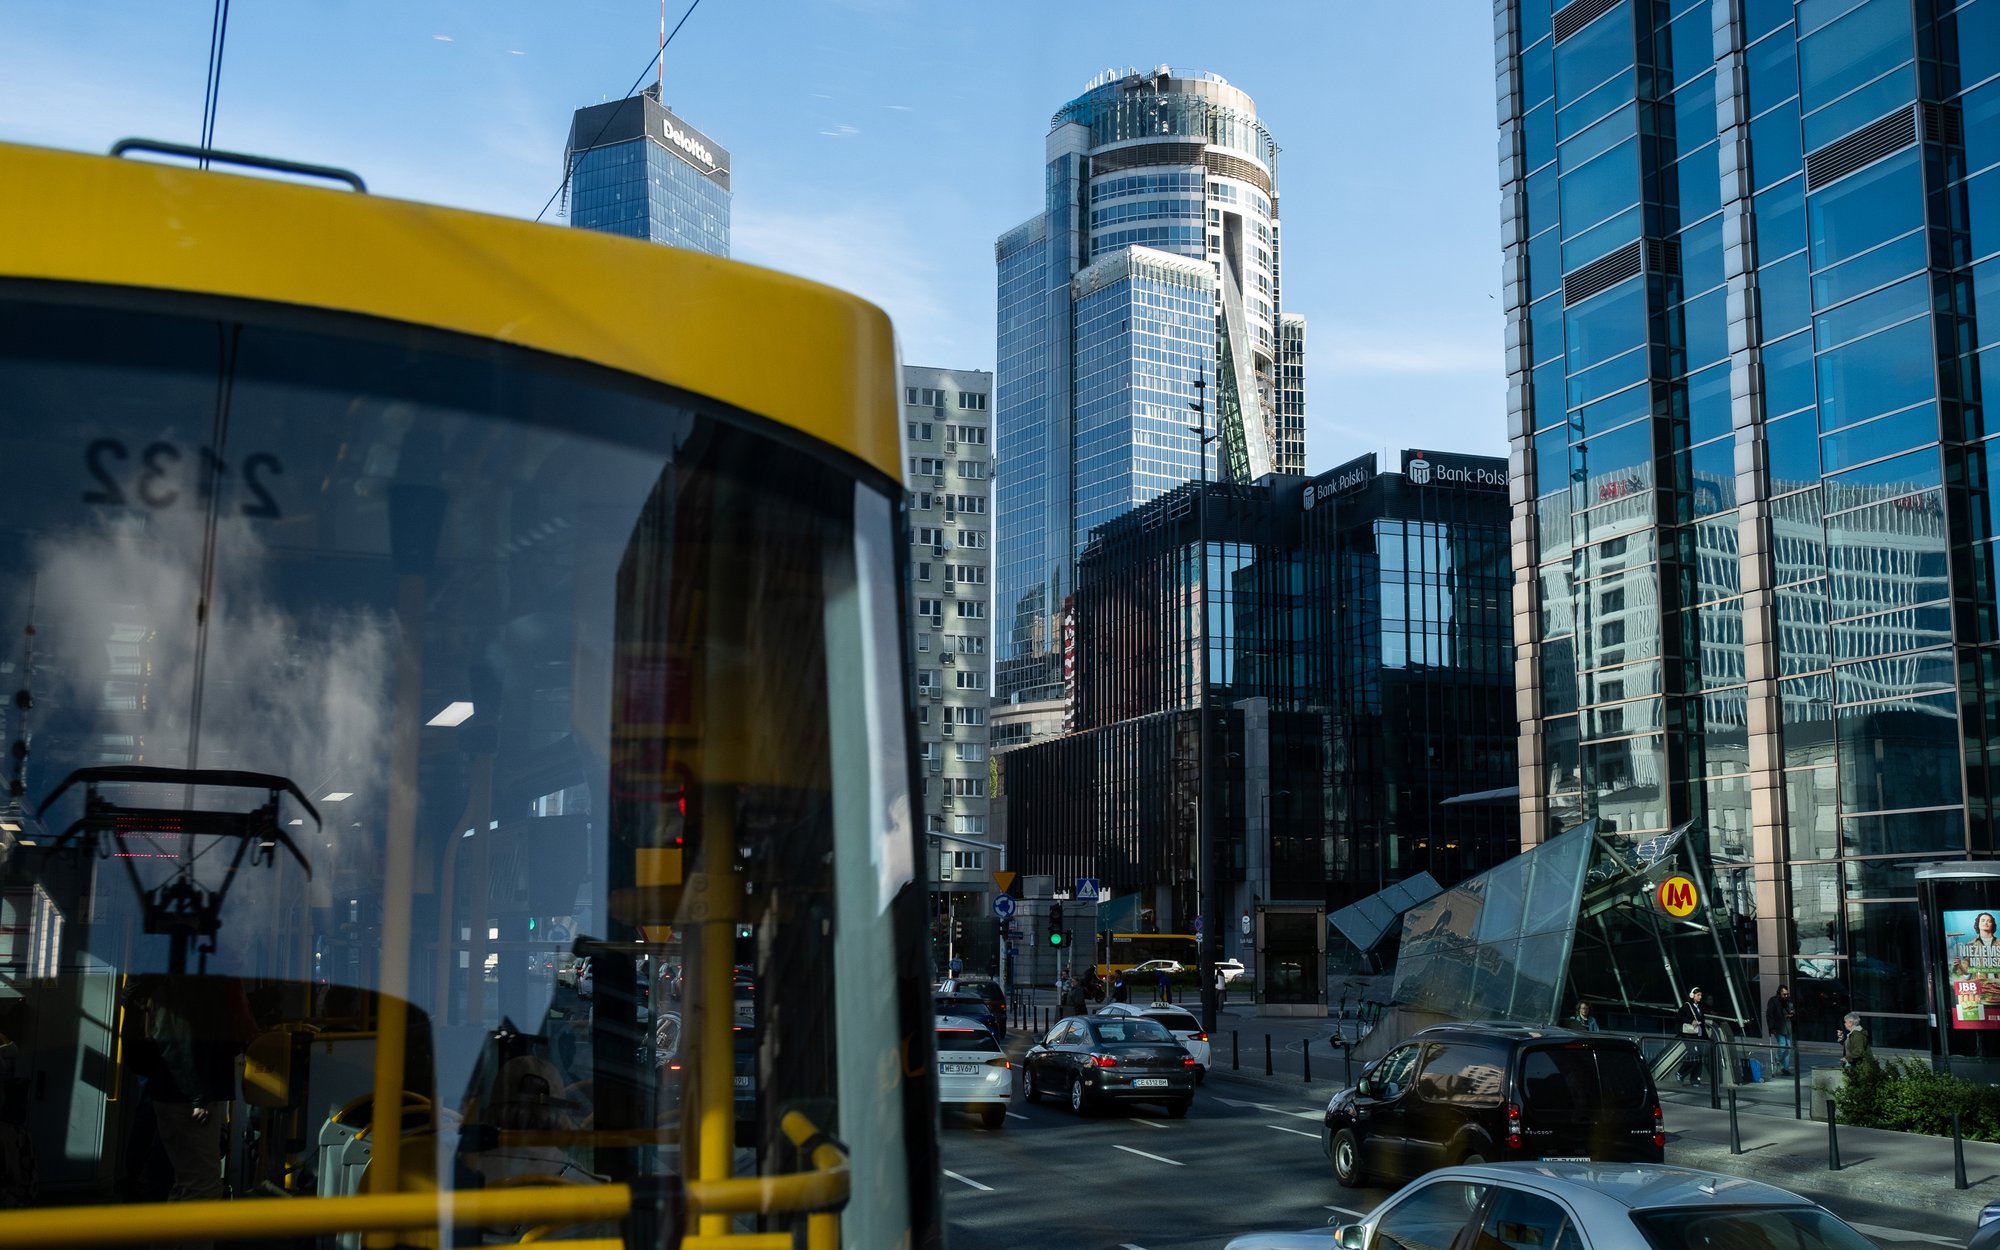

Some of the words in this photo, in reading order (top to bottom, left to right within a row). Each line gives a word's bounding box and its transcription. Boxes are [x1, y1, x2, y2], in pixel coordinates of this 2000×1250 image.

[663, 118, 716, 170] Deloitte.
[1436, 464, 1472, 482] Bank
[1316, 479, 1338, 500] Bank
[1338, 466, 1363, 492] Polski
[1970, 957, 1981, 967] NA
[1958, 982, 1977, 992] JBB
